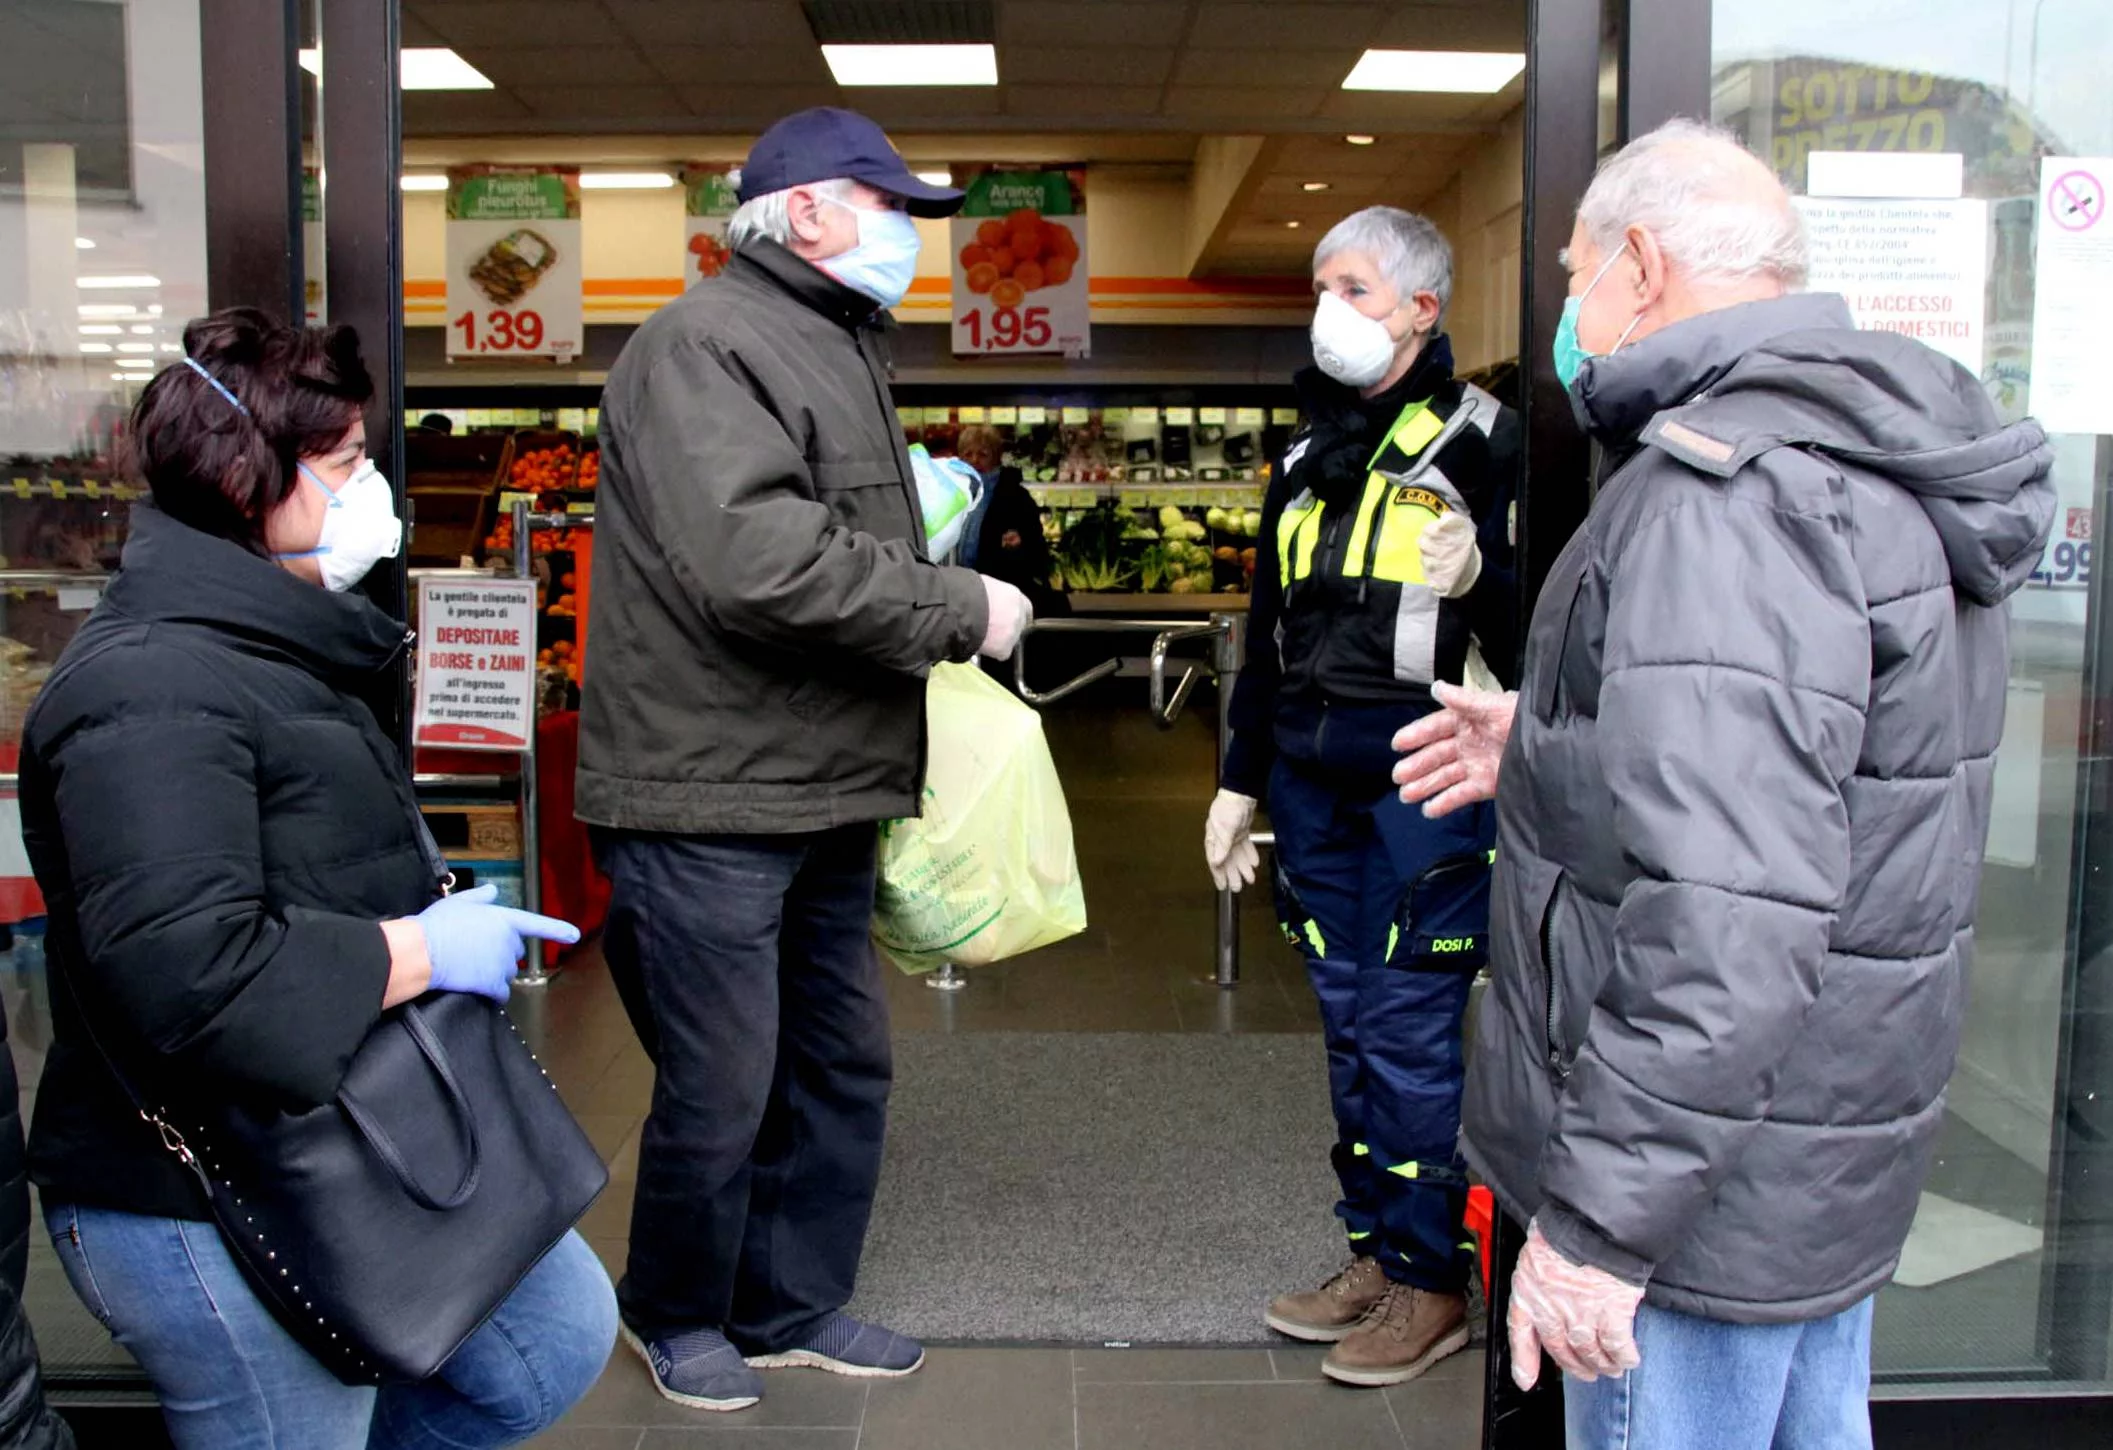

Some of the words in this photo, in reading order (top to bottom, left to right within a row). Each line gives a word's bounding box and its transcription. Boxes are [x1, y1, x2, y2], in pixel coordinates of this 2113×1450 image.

[1780, 69, 1933, 127] SOTTO
[990, 185, 1045, 199] Arance
[1858, 295, 1953, 312] L'ACCESSO
[454, 310, 543, 352] 1,39
[960, 307, 1052, 350] 1,95
[1874, 320, 1970, 338] DOMESTICI
[429, 591, 441, 601] La
[444, 592, 479, 603] gentile
[482, 593, 527, 604] clientela
[448, 606, 454, 617] è
[457, 607, 495, 619] pregata
[499, 607, 508, 618] di
[436, 627, 520, 646] DEPOSITARE
[430, 652, 473, 670] BORSE
[478, 657, 487, 670] e
[490, 654, 526, 671] ZAINI
[446, 677, 506, 690] all'ingresso
[429, 692, 458, 704] prima
[461, 693, 471, 703] di
[474, 694, 521, 705] accedere
[429, 707, 444, 717] nel
[447, 708, 520, 720] supermercato.
[1432, 938, 1463, 953] DOSI
[1465, 938, 1474, 951] P.
